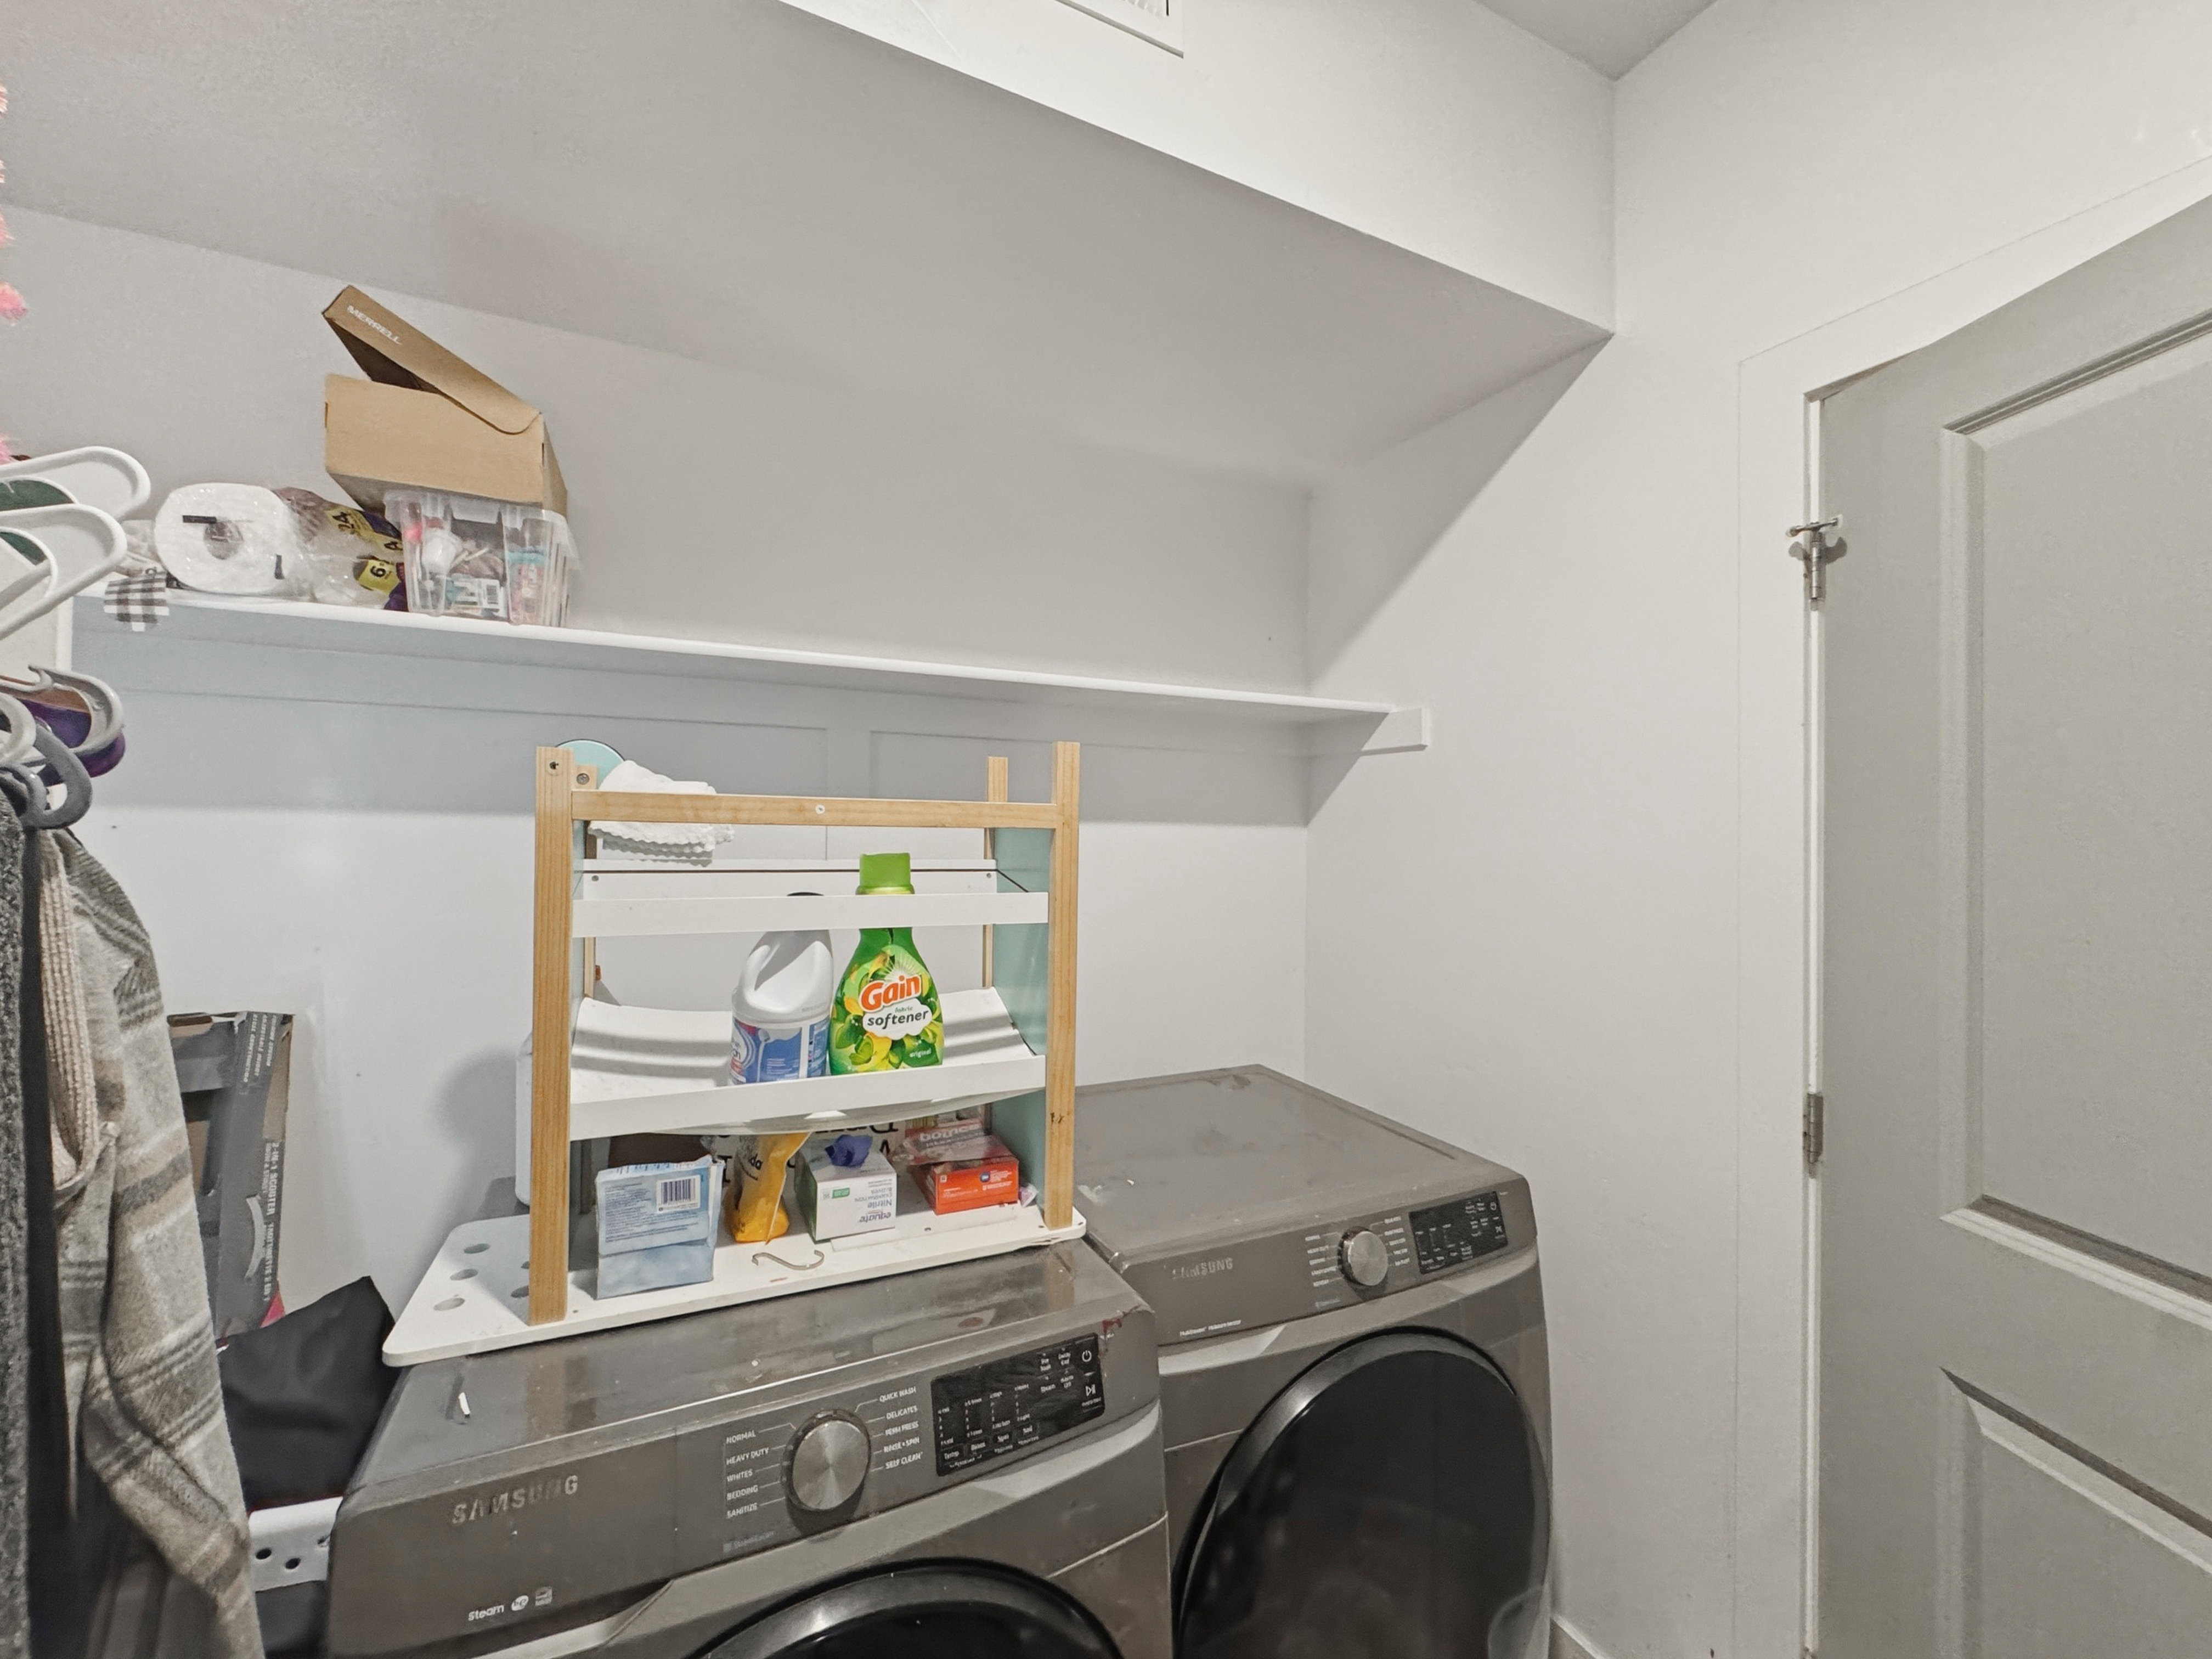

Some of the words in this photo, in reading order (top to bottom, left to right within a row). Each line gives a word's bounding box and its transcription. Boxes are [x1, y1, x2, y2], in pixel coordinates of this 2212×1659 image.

[347, 305, 402, 345] MERRELL
[861, 975, 921, 1011] Gain
[867, 1011, 929, 1029] softener
[909, 1048, 932, 1058] original
[267, 1172, 278, 1216] SCOOTER
[868, 1199, 892, 1209] Nitrile
[859, 1211, 891, 1222] equate
[1172, 1257, 1233, 1279] MSUNG
[879, 1391, 898, 1402] QUICK
[899, 1386, 916, 1396] WASH
[886, 1405, 917, 1419] DELICATES
[726, 1430, 756, 1444] NORMAL
[906, 1437, 919, 1447] SPIN
[726, 1453, 749, 1465] HEAVY
[751, 1447, 769, 1458] DUTY
[885, 1459, 900, 1469] SELF
[727, 1469, 753, 1482] WHITES
[452, 1475, 578, 1524] SAMSUNG
[727, 1485, 758, 1500] BEDDING
[727, 1502, 758, 1519] SANITIZE
